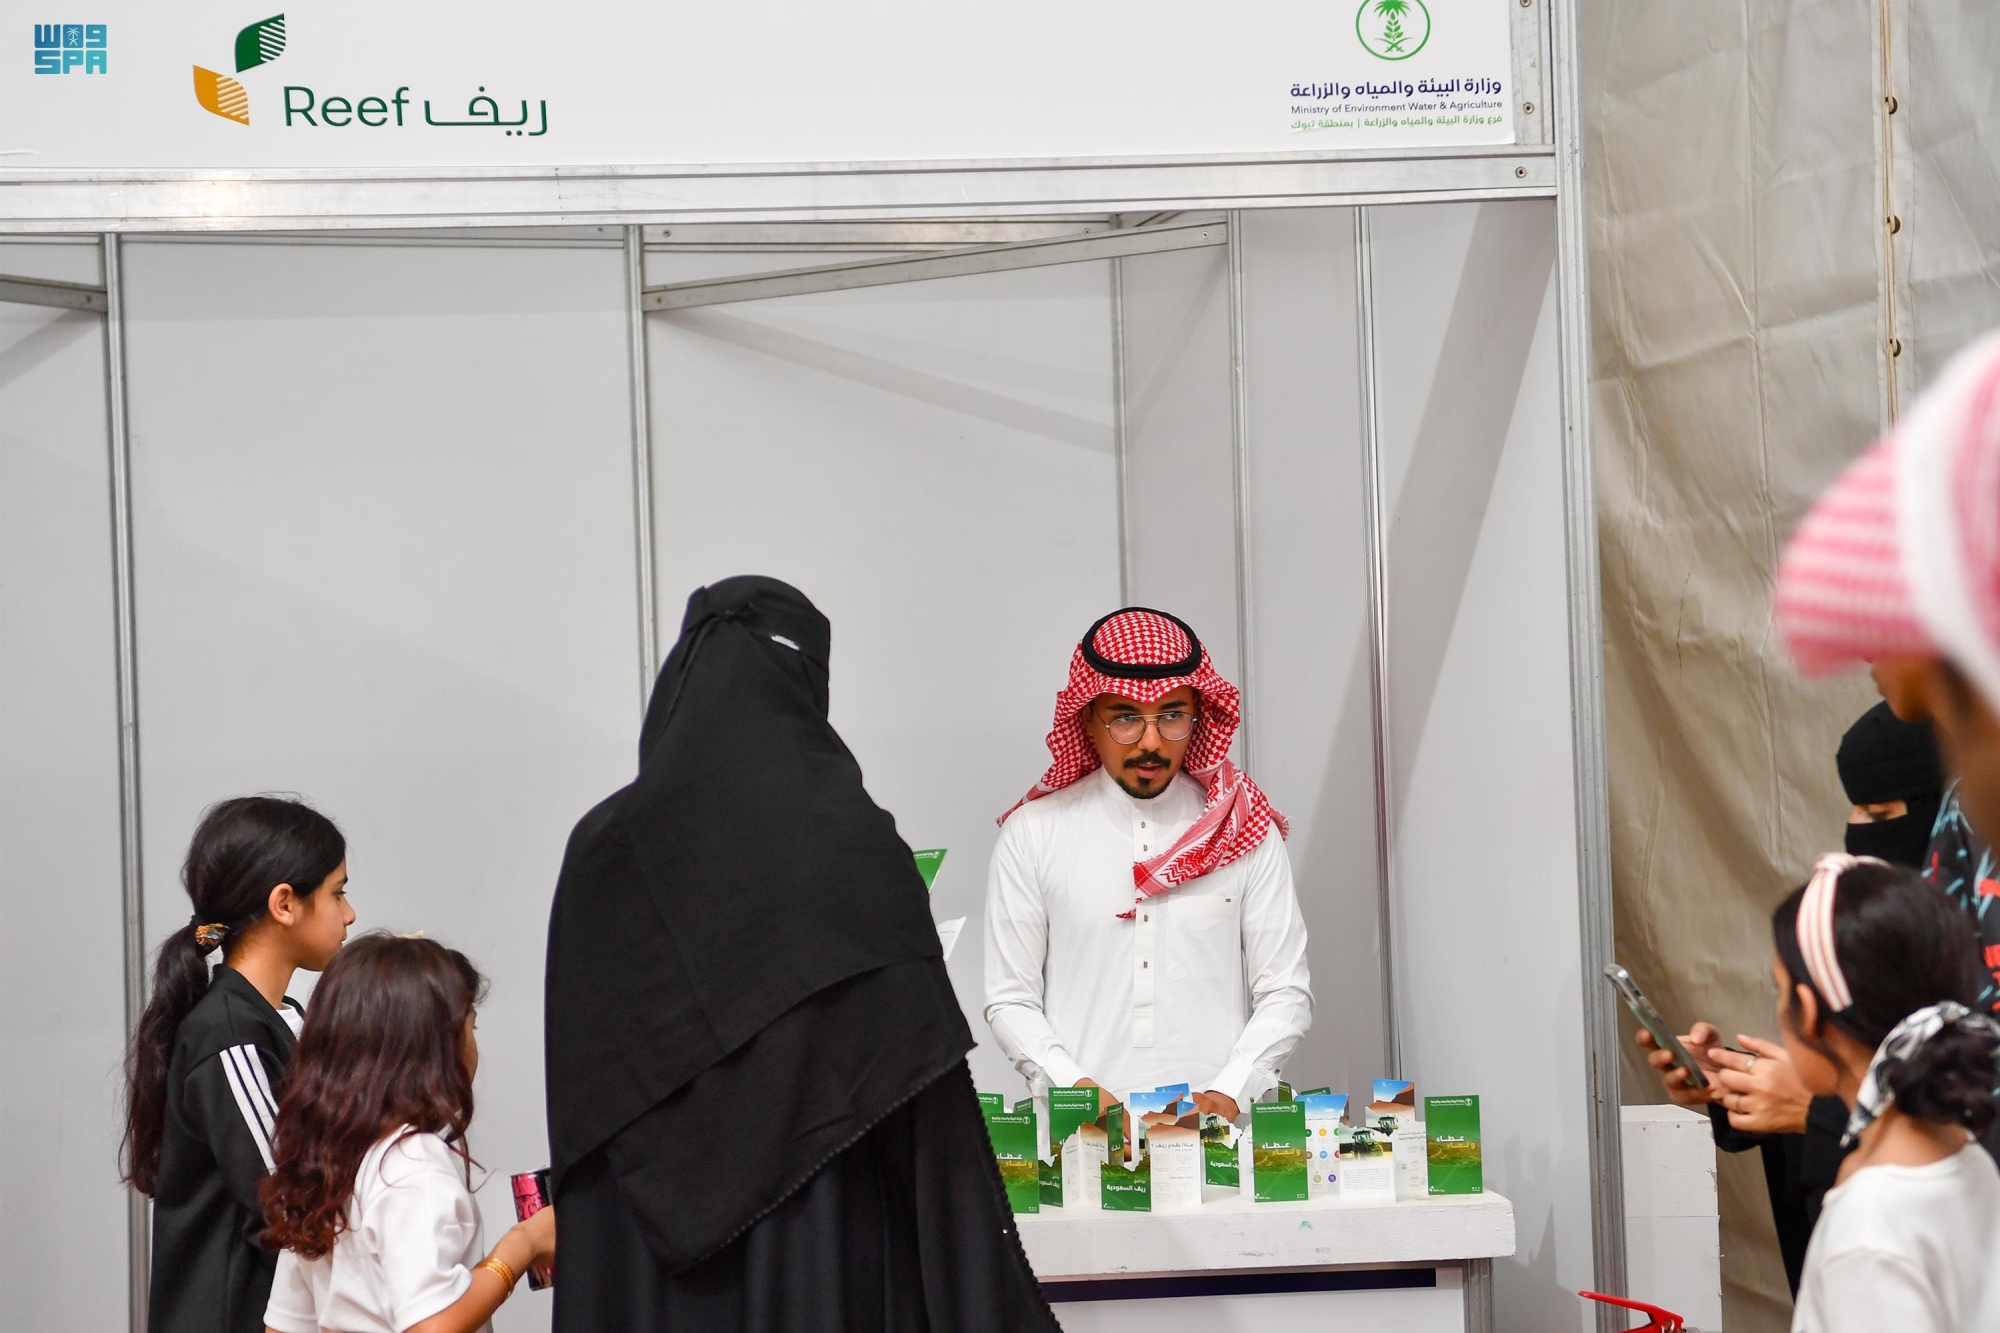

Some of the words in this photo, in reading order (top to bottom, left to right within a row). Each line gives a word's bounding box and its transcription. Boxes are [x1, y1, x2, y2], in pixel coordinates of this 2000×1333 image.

[1290, 82, 1351, 100] والزراعة
[1355, 80, 1414, 99] والمياه
[1418, 78, 1460, 97] البيئة
[1464, 78, 1502, 95] وزارة
[283, 86, 410, 127] Reef
[424, 86, 547, 136] ريف
[1291, 106, 1329, 115] Ministry
[1332, 104, 1342, 113] of
[1344, 102, 1406, 113] Environment
[1408, 102, 1437, 111] Water
[1439, 101, 1447, 110] &
[1449, 100, 1503, 111] Agriculture
[1318, 119, 1354, 129] بمنطقة
[1364, 118, 1398, 128] والزراعة
[1400, 116, 1434, 127] والمياه
[1436, 116, 1460, 126] البيئة
[1462, 115, 1485, 125] وزارة
[1487, 114, 1503, 125] فرع
[1106, 1184, 1133, 1192] السعودية
[1133, 1185, 1146, 1193] ريف
